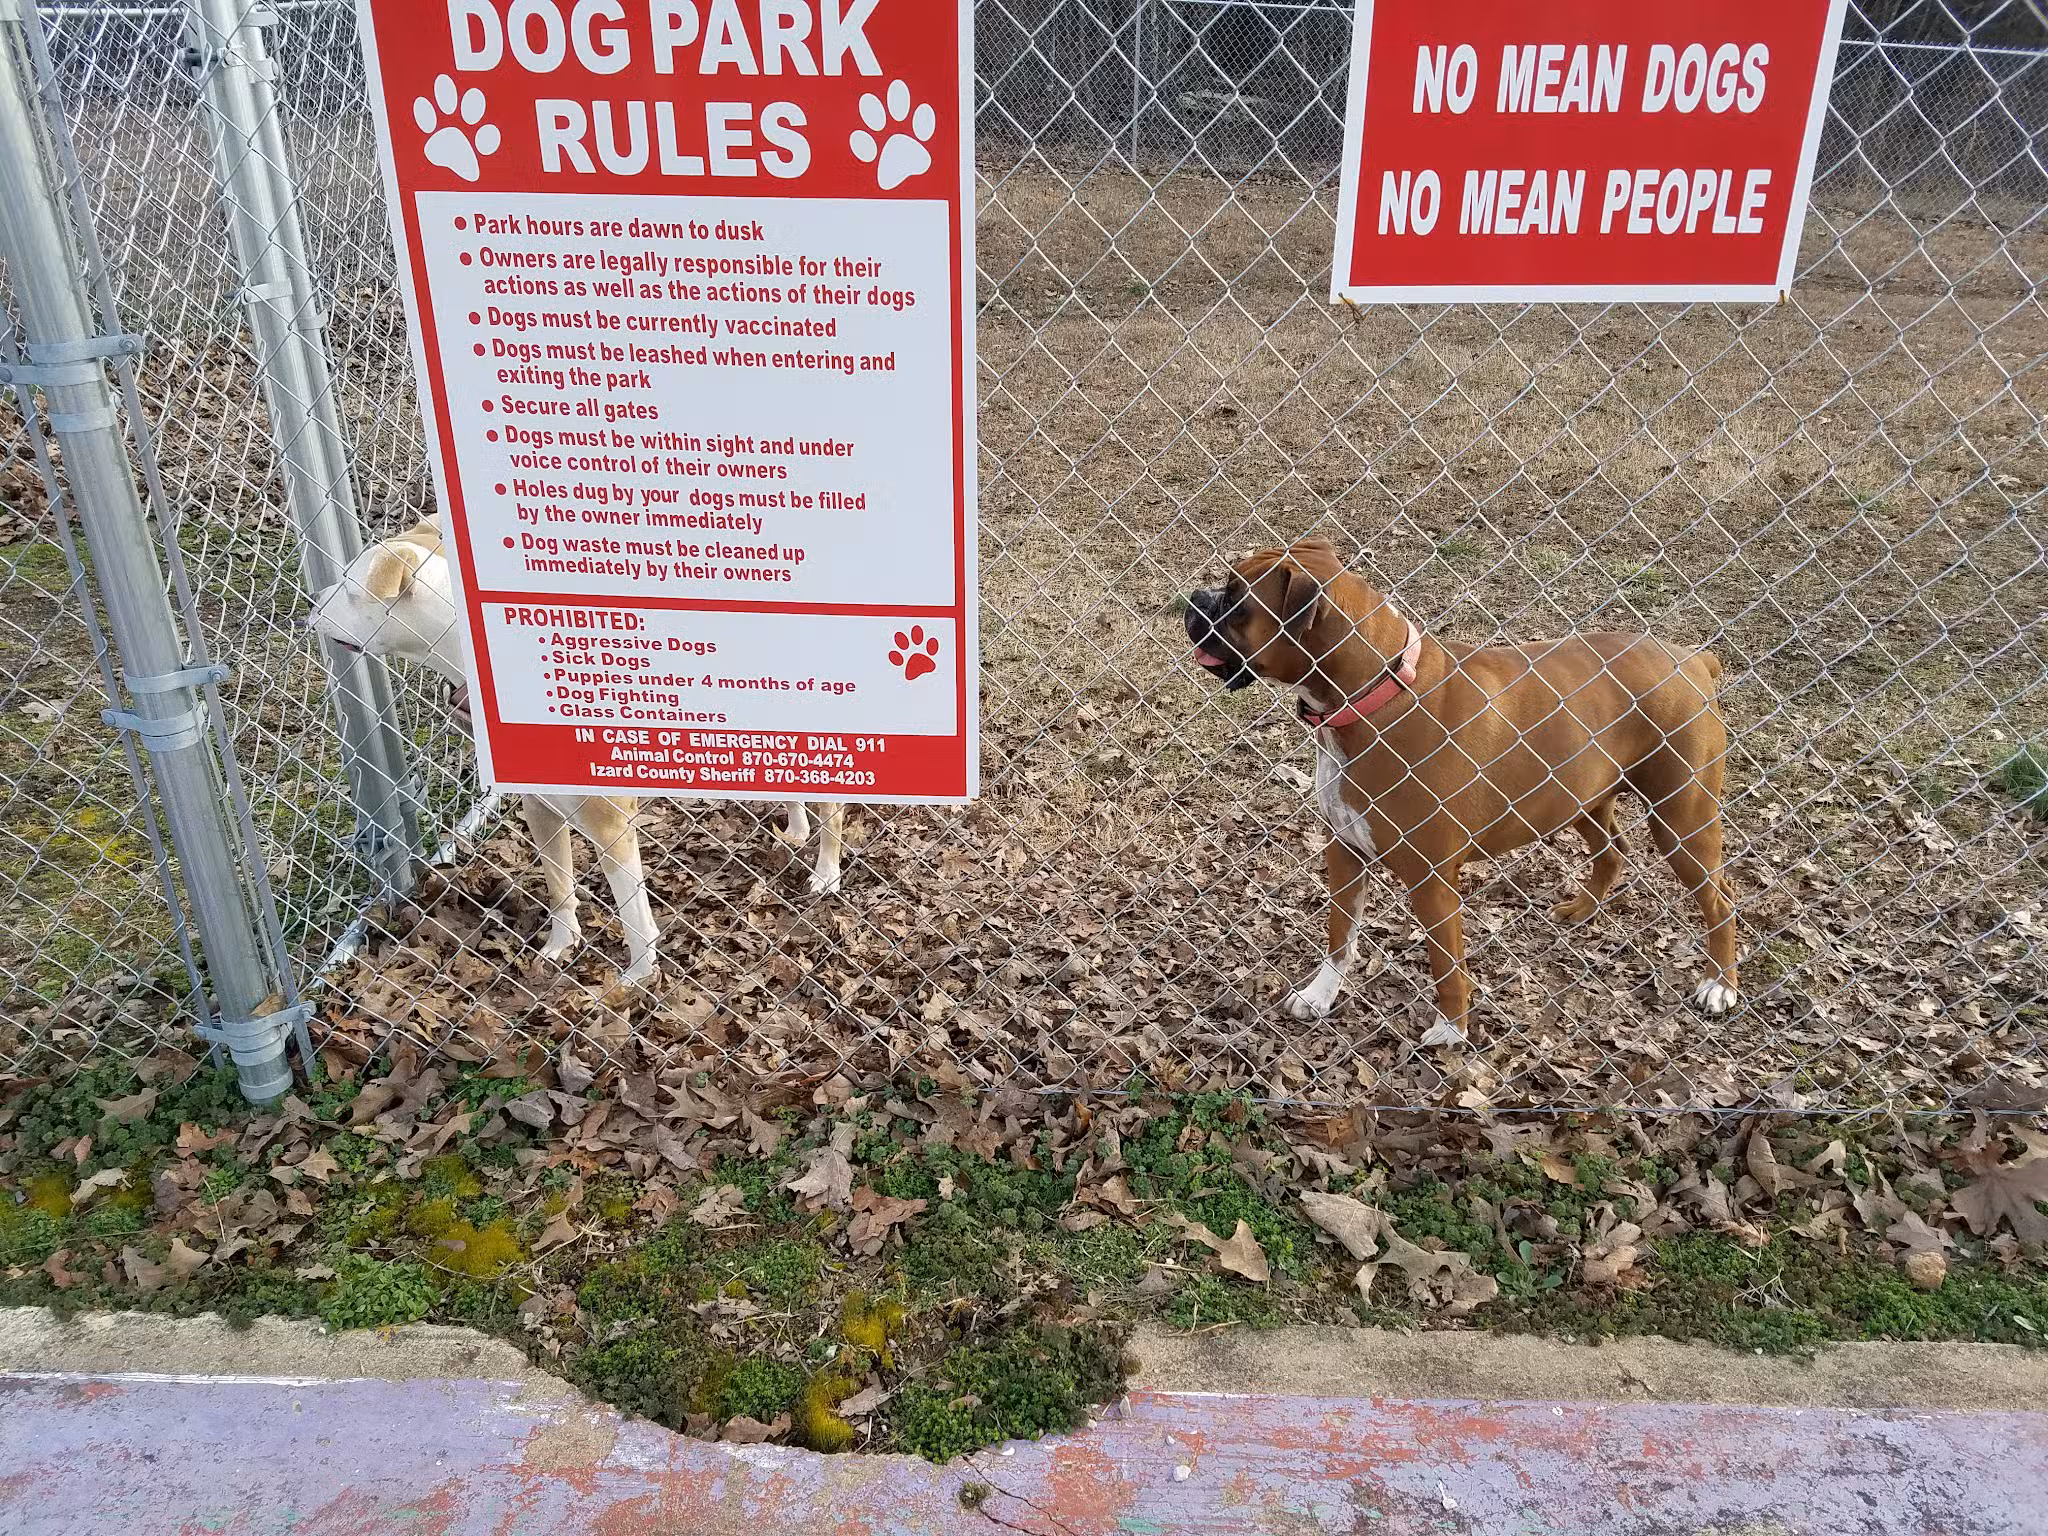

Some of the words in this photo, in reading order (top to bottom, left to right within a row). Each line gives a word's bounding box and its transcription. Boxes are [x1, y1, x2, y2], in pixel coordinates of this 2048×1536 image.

[447, 0, 630, 74] DOG
[649, 0, 882, 76] PARK
[1413, 44, 1478, 114] NO
[1496, 44, 1628, 112] MEAN
[1642, 42, 1769, 114] DOGS
[536, 99, 810, 178] RULES
[1378, 170, 1441, 236] NO
[1460, 170, 1586, 234] MEAN
[1600, 168, 1772, 234] PEOPLE
[474, 213, 521, 234] Park
[526, 216, 584, 238] hours
[590, 221, 622, 237] are
[628, 217, 683, 239] dawn
[688, 220, 709, 240] to
[715, 219, 764, 240] dusk
[480, 247, 558, 268] Owners
[563, 254, 595, 270] are
[600, 250, 668, 276] legally
[674, 256, 792, 278] responsible
[798, 256, 828, 276] for
[833, 257, 880, 278] their
[484, 274, 558, 295] actions
[564, 281, 588, 296] as
[593, 278, 634, 298] well
[640, 284, 663, 300] as
[668, 280, 700, 300] the
[706, 283, 782, 303] actions
[788, 284, 806, 304] of
[814, 284, 860, 305] their
[867, 286, 915, 312] dogs
[488, 306, 537, 332] Dogs
[542, 312, 592, 328] must
[596, 310, 620, 330] be
[626, 314, 718, 338] currently
[725, 316, 836, 337] vaccinated
[492, 338, 542, 363] Dogs
[546, 344, 596, 360] must
[600, 342, 624, 362] be
[630, 344, 708, 365] leashed
[712, 348, 766, 368] when
[772, 350, 855, 375] entering
[860, 352, 895, 371] and
[497, 366, 564, 390] exiting
[568, 367, 600, 387] the
[606, 370, 650, 392] park
[501, 394, 571, 416] Secure
[576, 399, 599, 416] all
[604, 402, 659, 423] gates
[505, 425, 554, 449] Dogs
[558, 431, 606, 447] must
[610, 430, 634, 448] be
[640, 432, 701, 452] within
[706, 434, 754, 458] sight
[760, 437, 794, 455] and
[800, 438, 854, 456] under
[512, 451, 562, 470] voice
[566, 456, 636, 472] control
[640, 456, 660, 474] of
[665, 457, 710, 476] their
[717, 464, 787, 479] owners
[513, 479, 568, 498] Holes
[573, 483, 608, 505] dug
[612, 484, 634, 506] by
[641, 489, 679, 507] your
[690, 488, 735, 511] dogs
[739, 491, 786, 508] must
[790, 491, 813, 508] be
[818, 492, 866, 512] filled
[516, 504, 538, 526] by
[545, 504, 576, 523] the
[582, 510, 640, 525] owner
[646, 508, 762, 535] immediately
[521, 532, 558, 556] Dog
[563, 538, 620, 554] waste
[624, 540, 672, 556] must
[677, 540, 700, 558] be
[705, 542, 778, 560] cleaned
[784, 548, 805, 564] up
[525, 556, 640, 580] immediately
[646, 560, 667, 581] by
[674, 561, 718, 579] their
[723, 568, 791, 582] owners
[504, 608, 645, 630] PROHIBITED:
[552, 632, 662, 650] Aggressive
[666, 638, 716, 656] Dogs
[552, 650, 594, 665] Sick
[601, 652, 650, 670] Dogs
[554, 668, 632, 686] Puppies
[638, 673, 695, 687] under
[701, 675, 712, 687] 4
[718, 677, 790, 690] months
[796, 678, 814, 691] of
[821, 682, 856, 695] age
[556, 686, 595, 703] Dog
[599, 687, 679, 707] Fighting
[560, 703, 615, 718] Glass
[620, 705, 726, 722] Containers
[576, 728, 594, 742] IN
[602, 729, 650, 744] CASE
[658, 732, 680, 746] OF
[689, 732, 798, 750] EMERGENCY
[808, 736, 848, 752] DIAL
[856, 738, 884, 752] 911
[611, 746, 670, 762] Animal
[672, 749, 734, 764] Control
[742, 751, 854, 768] 870-670-4474
[590, 762, 634, 778] Izard
[636, 764, 695, 784] County
[700, 767, 755, 782] Sheriff
[764, 768, 875, 786] 870-368-4203
